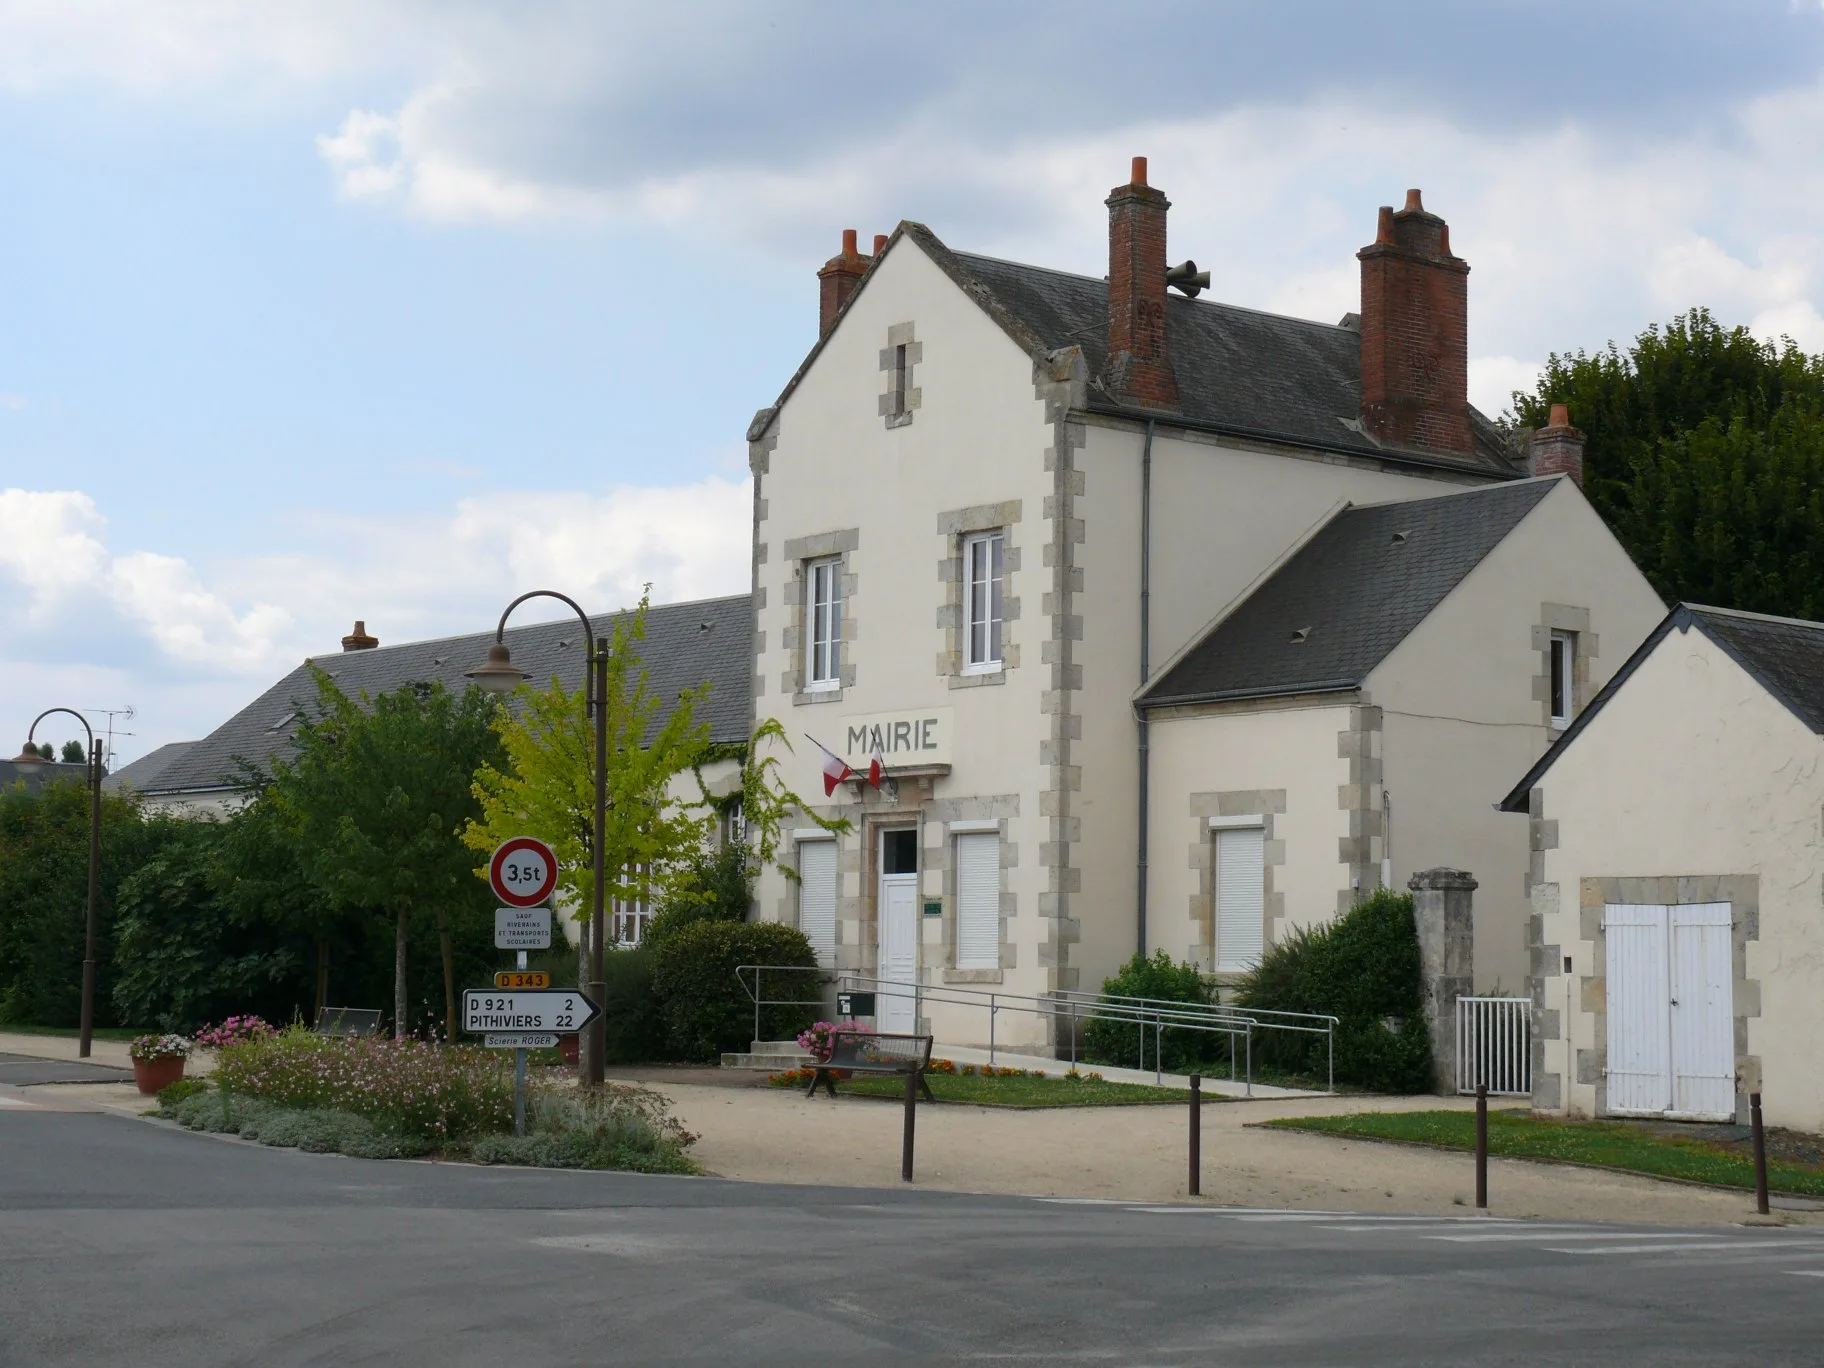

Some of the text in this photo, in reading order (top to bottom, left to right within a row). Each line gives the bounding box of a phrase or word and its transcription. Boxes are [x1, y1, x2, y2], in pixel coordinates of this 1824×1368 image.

[847, 718, 938, 755] MAIRIE
[507, 864, 541, 884] 3,5t
[502, 975, 543, 986] D 343
[470, 999, 573, 1011] D 921 2
[470, 1015, 573, 1027] PITHIVIERS 22
[488, 1035, 552, 1045] Scierie ROGER
